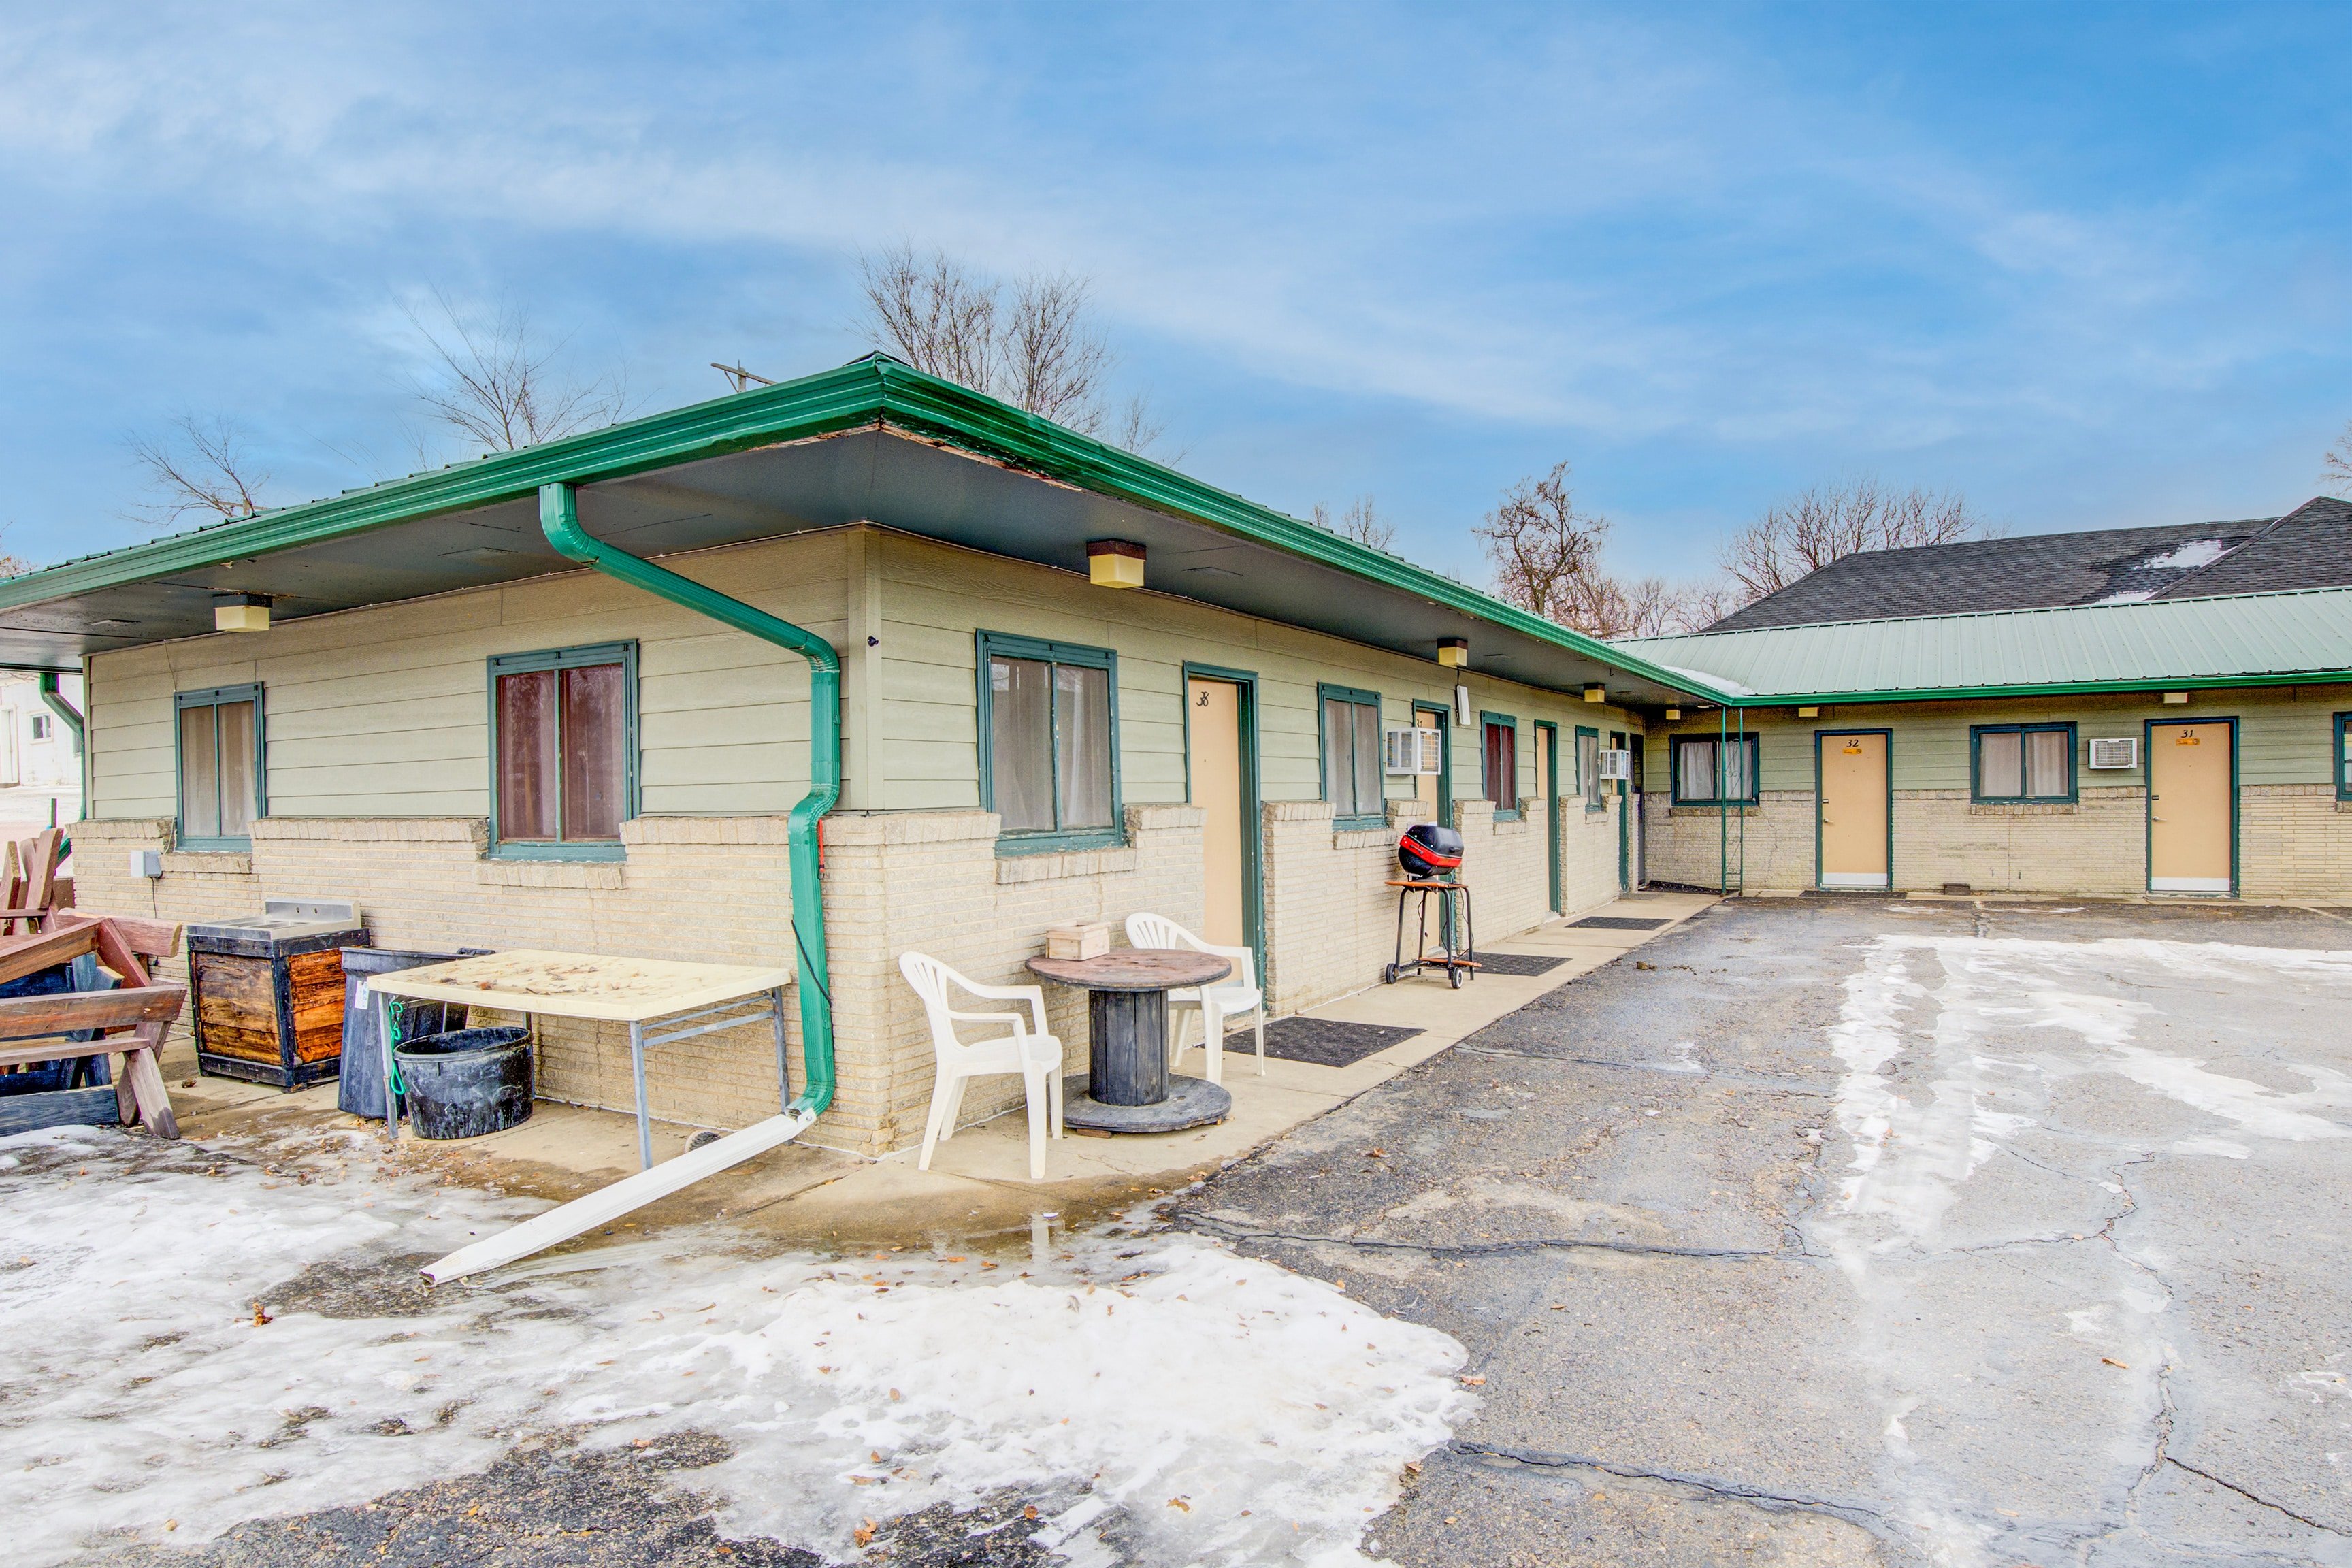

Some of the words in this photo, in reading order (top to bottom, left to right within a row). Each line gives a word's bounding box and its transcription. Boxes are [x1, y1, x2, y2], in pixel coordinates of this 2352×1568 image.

[1196, 691, 1210, 707] 38
[2180, 729, 2194, 738] 31
[1846, 739, 1859, 747] 32
